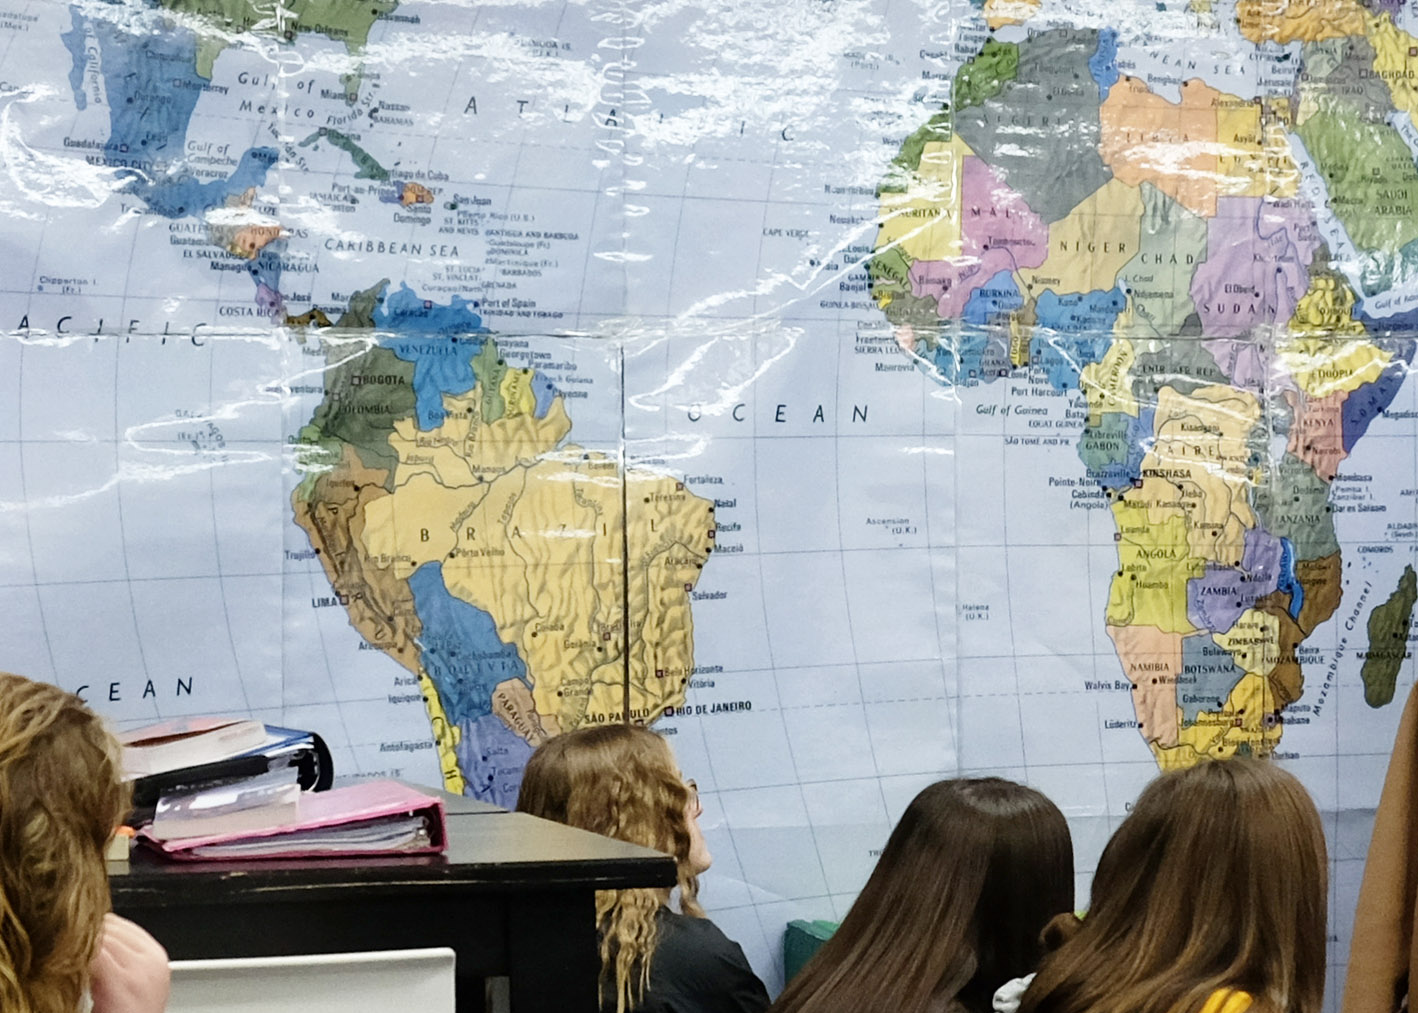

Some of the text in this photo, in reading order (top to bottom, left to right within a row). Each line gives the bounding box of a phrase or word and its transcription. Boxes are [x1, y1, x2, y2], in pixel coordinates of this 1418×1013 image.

[1368, 70, 1415, 80] BAGHDAD
[297, 80, 315, 94] of
[187, 140, 230, 154] Gulf of
[1376, 191, 1408, 199] SAUDI
[1374, 206, 1413, 215] ARABIA
[324, 238, 459, 257] CARIBBEAN SEA
[1060, 241, 1126, 252] NIGER
[1141, 253, 1194, 265] CHAD
[482, 297, 500, 307] Port
[512, 299, 536, 309] Spain
[1204, 303, 1275, 314] SUDAN
[219, 306, 253, 316] COSTA
[1011, 387, 1067, 397] Port Harcourt
[688, 404, 868, 423] OCEAN
[976, 404, 997, 416] Gulf
[1001, 405, 1012, 415] of
[1303, 418, 1334, 428] KENYA
[1085, 441, 1119, 450] GABON
[1142, 468, 1191, 479] KINSHASA
[1070, 501, 1109, 510] (Angola)
[1136, 549, 1177, 558] ANGOLA
[692, 591, 727, 601] Salvador
[1200, 586, 1237, 596] ZAMBIA
[312, 598, 337, 609] LIMA
[1313, 581, 1372, 717] Mozambique Channel
[1130, 663, 1169, 671] NAMIBIA
[1184, 665, 1236, 674] BOTSWANA
[1084, 680, 1111, 692] Walvis
[676, 701, 752, 716] RIO DE JANEIRO
[497, 693, 537, 742] PARAGUAY
[380, 741, 432, 753] Antofagasta
